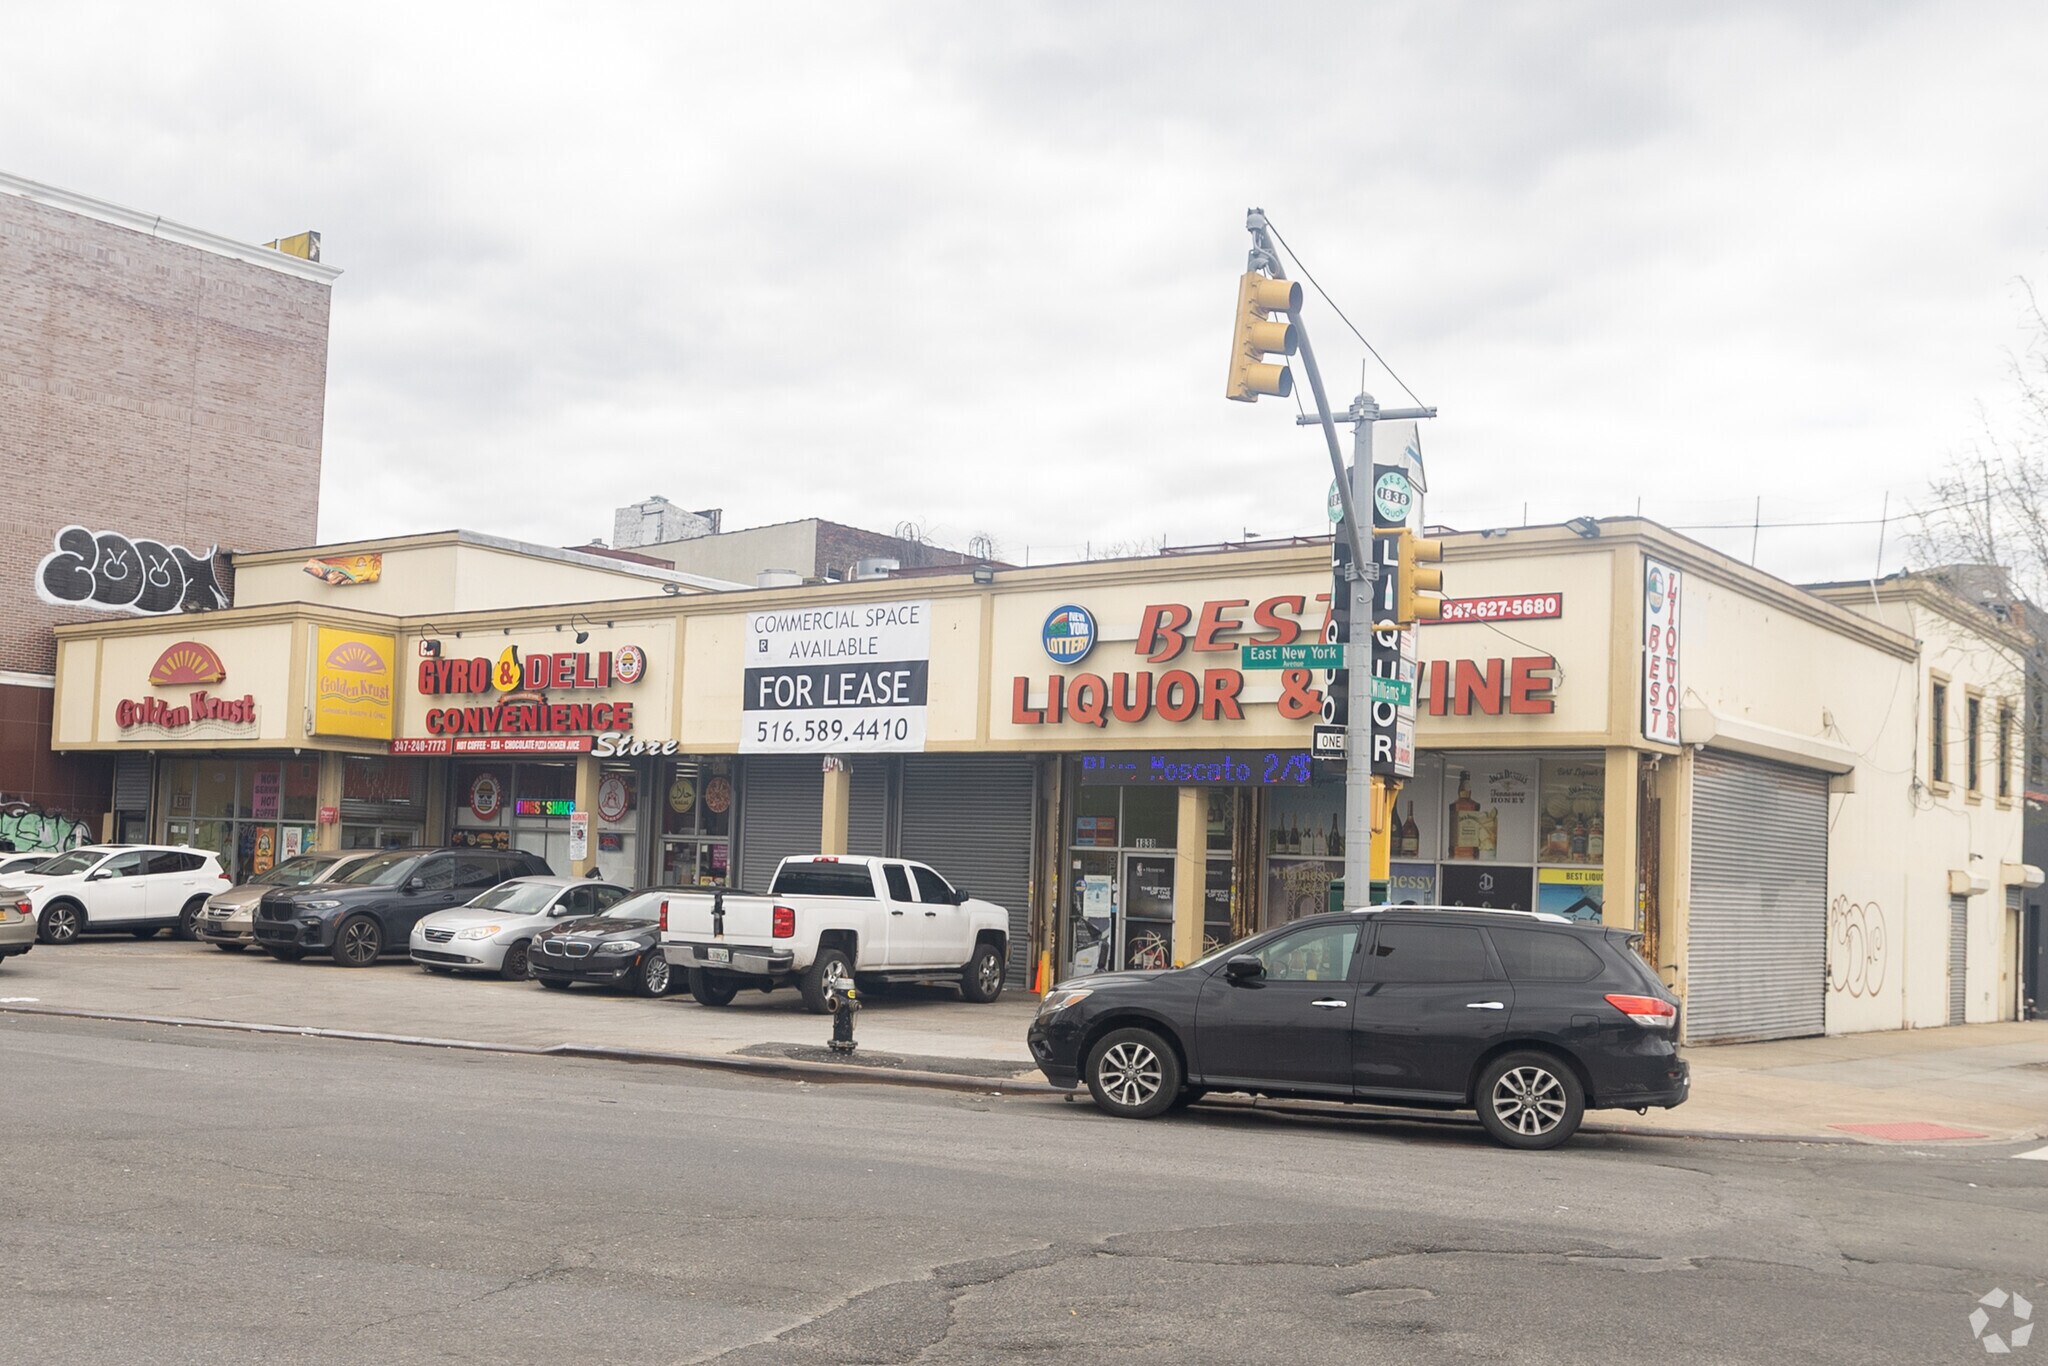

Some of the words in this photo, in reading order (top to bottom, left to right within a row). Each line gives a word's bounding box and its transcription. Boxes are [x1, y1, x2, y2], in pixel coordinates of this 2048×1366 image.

[1382, 476, 1408, 491] BEST
[1379, 488, 1407, 505] 1838
[1379, 502, 1404, 519] LIQUOR
[754, 609, 859, 634] COMMERCIAL
[866, 605, 920, 627] SPACE
[1069, 611, 1086, 622] NEW
[1442, 597, 1557, 620] 347-627-5680
[1070, 622, 1089, 635] YORK
[789, 637, 878, 659] AVAILABLE
[1047, 636, 1089, 655] LOTTERY
[1250, 647, 1277, 660] East
[1282, 646, 1306, 659] New
[1311, 646, 1337, 659] York
[1666, 572, 1677, 739] LIQUOR
[418, 657, 490, 695] GYRO
[500, 661, 513, 685] &
[524, 651, 611, 690] DELI
[1649, 624, 1661, 733] BEST
[320, 676, 359, 697] Golden
[360, 679, 389, 700] Krust
[759, 675, 813, 708] FOR
[823, 671, 911, 705] LEASE
[1372, 680, 1400, 702] Williams
[1417, 655, 1557, 717] INE
[1012, 668, 1244, 728] LIQUOR
[1277, 668, 1322, 719] &
[115, 696, 190, 729] Golden
[190, 691, 257, 723] Krust
[426, 702, 634, 735] CONVENIENCE
[757, 718, 908, 742] 516.589.4410
[467, 741, 486, 750] COFFEE
[490, 741, 500, 750] TEA
[504, 740, 535, 750] CHOCOLATE
[547, 740, 566, 750] CHICKEN
[567, 740, 580, 750] JUICE
[591, 732, 679, 757] Store
[1322, 735, 1342, 748] ONE
[261, 774, 278, 783] NOW
[1151, 755, 1250, 781] Moscato
[260, 796, 276, 807] HOT
[1136, 838, 1157, 849] 1838
[1389, 873, 1435, 891] nessy
[1566, 872, 1583, 881] BEST
